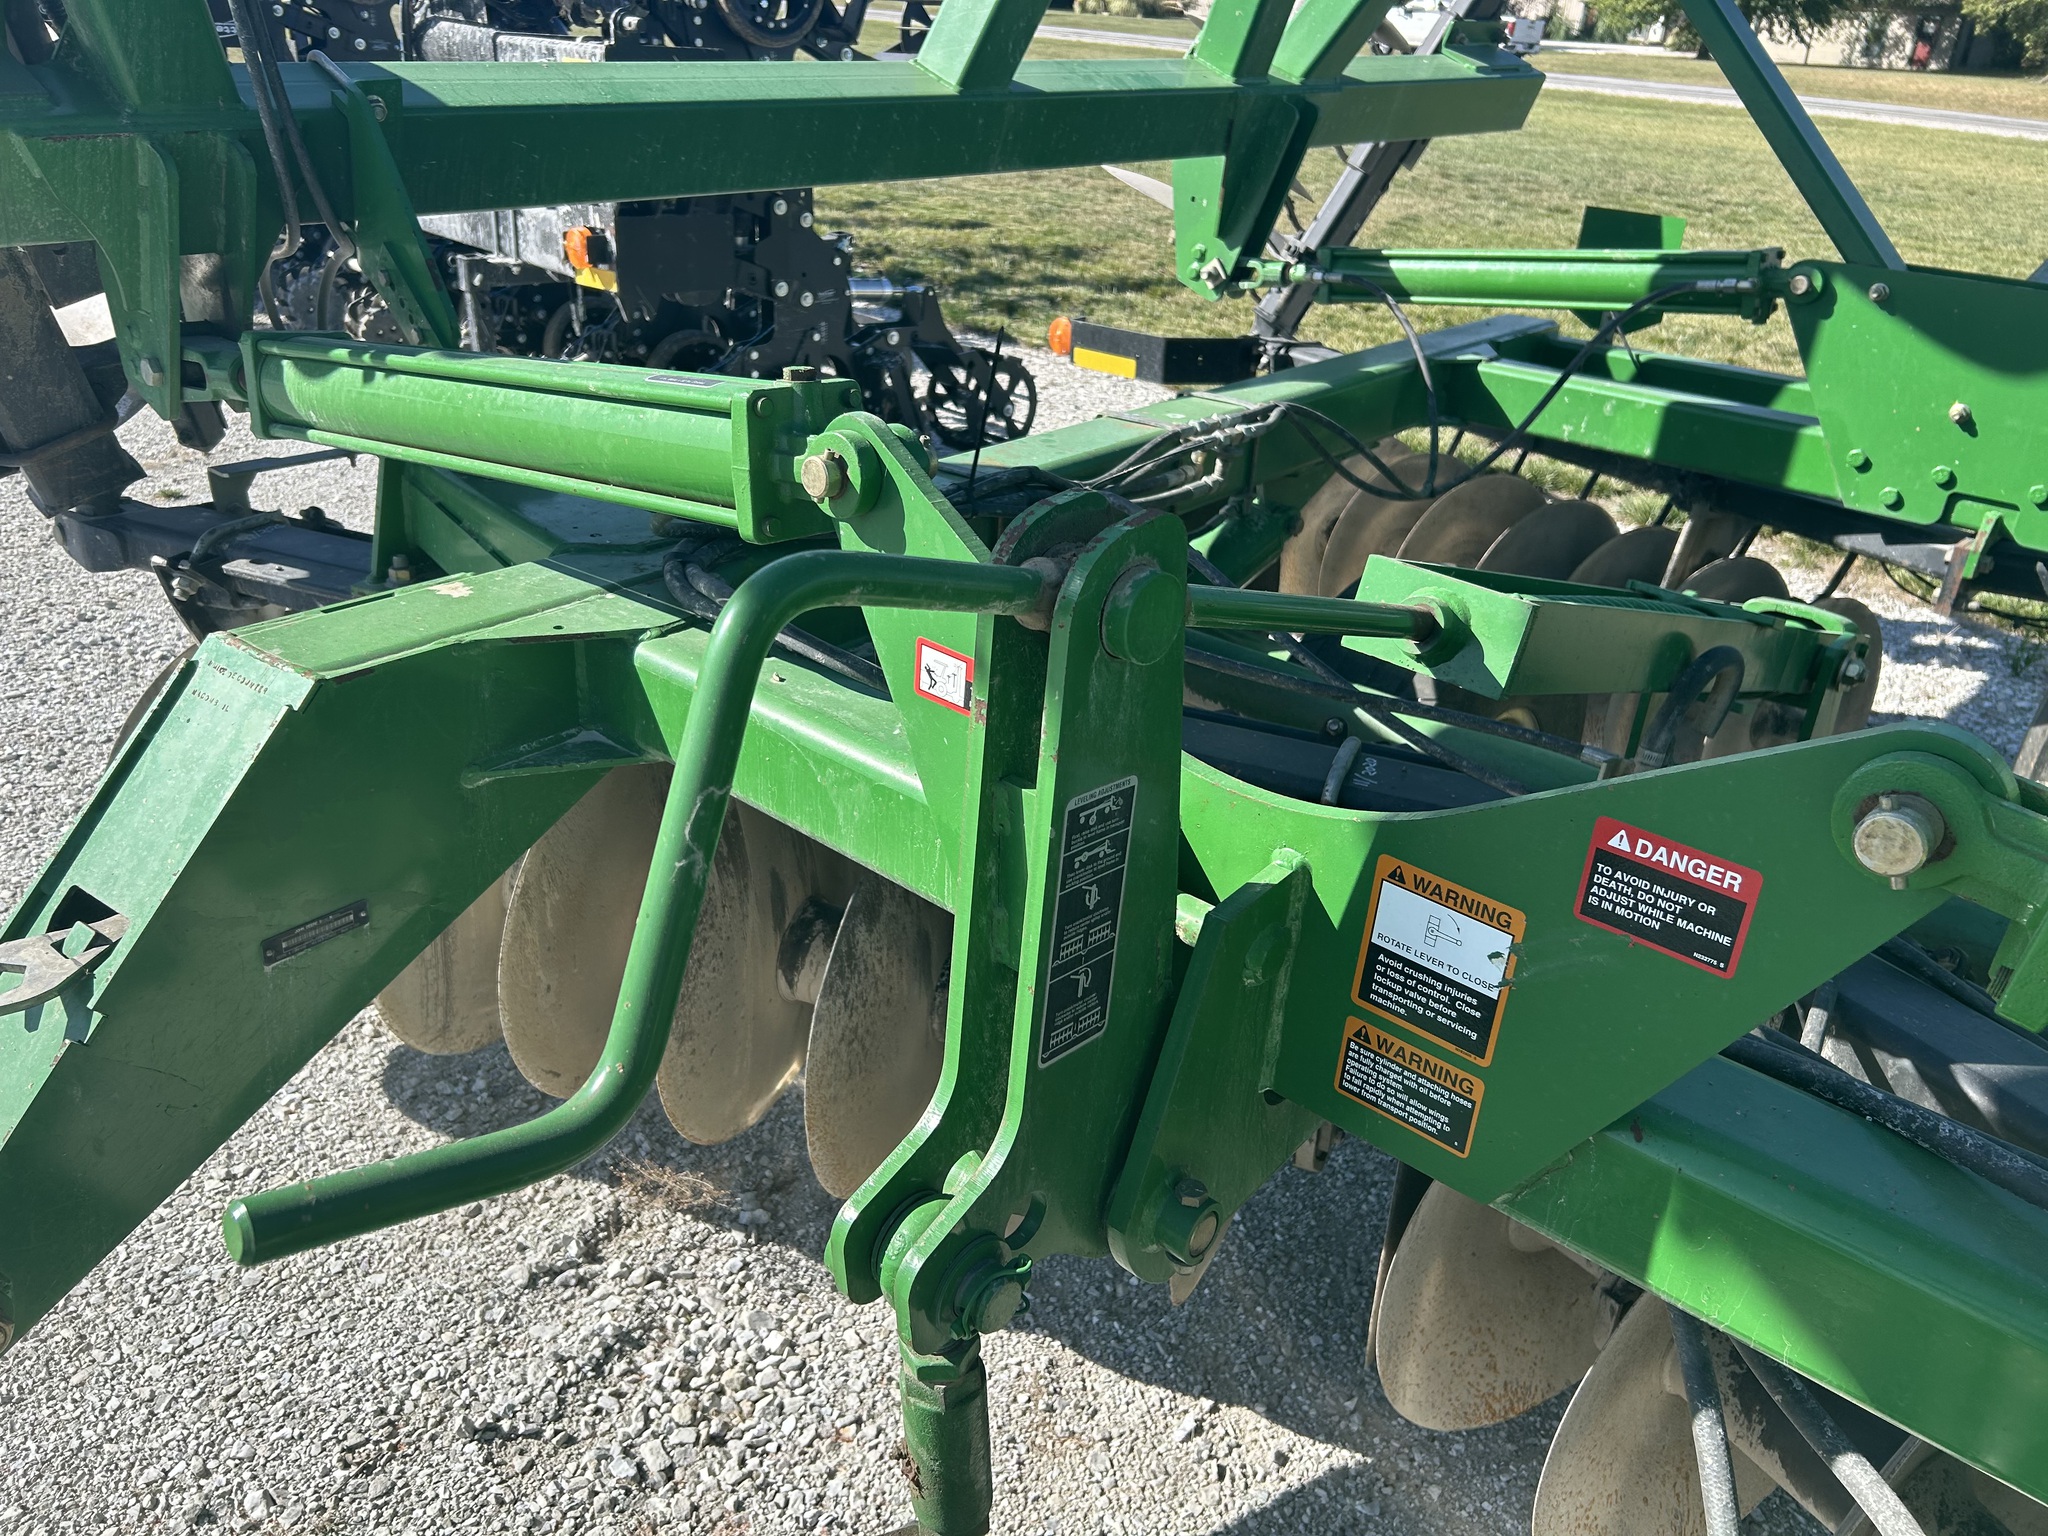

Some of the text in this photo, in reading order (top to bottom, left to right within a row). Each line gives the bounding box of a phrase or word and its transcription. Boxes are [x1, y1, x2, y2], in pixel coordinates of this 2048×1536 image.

[1074, 779, 1131, 806] LEVELING ADJUSTMENTS
[1597, 863, 1716, 916] TO AVOID INJURY OR
[1635, 838, 1742, 893] DANGER
[1413, 874, 1512, 930] WARNING
[1588, 896, 1660, 930] IS IN MOTION
[1590, 886, 1732, 946] ADJUST WHILE MACHINE
[1594, 874, 1683, 914] DEATH, DO NOT
[1377, 933, 1495, 992] ROTATE LEVER TO CLOSE
[1378, 953, 1478, 1005] Avoid crushing injuries
[1369, 993, 1407, 1016] machine.
[1372, 983, 1478, 1039] transporting or servicing
[1374, 973, 1457, 1018] lockup valve before
[1376, 964, 1481, 1019] or loss of control. Close
[1347, 1058, 1404, 1091] operating system.
[1348, 1050, 1451, 1107] are fully charged with oil before
[1350, 1041, 1473, 1109] Be sure cylinder and attaching hoses
[1376, 1034, 1474, 1096] WARNING
[1343, 1080, 1438, 1135] lower from transport position.
[1345, 1066, 1367, 1080] Failure
[1377, 1080, 1385, 1090] do
[1386, 1086, 1395, 1095] so
[1397, 1090, 1408, 1101] will
[1409, 1097, 1427, 1111] allow
[1428, 1108, 1449, 1123] wings
[1352, 1076, 1362, 1087] fail
[1363, 1083, 1386, 1100] rapidly
[1387, 1094, 1405, 1108] when
[1406, 1103, 1442, 1128] attempting
[1443, 1124, 1450, 1132] to
